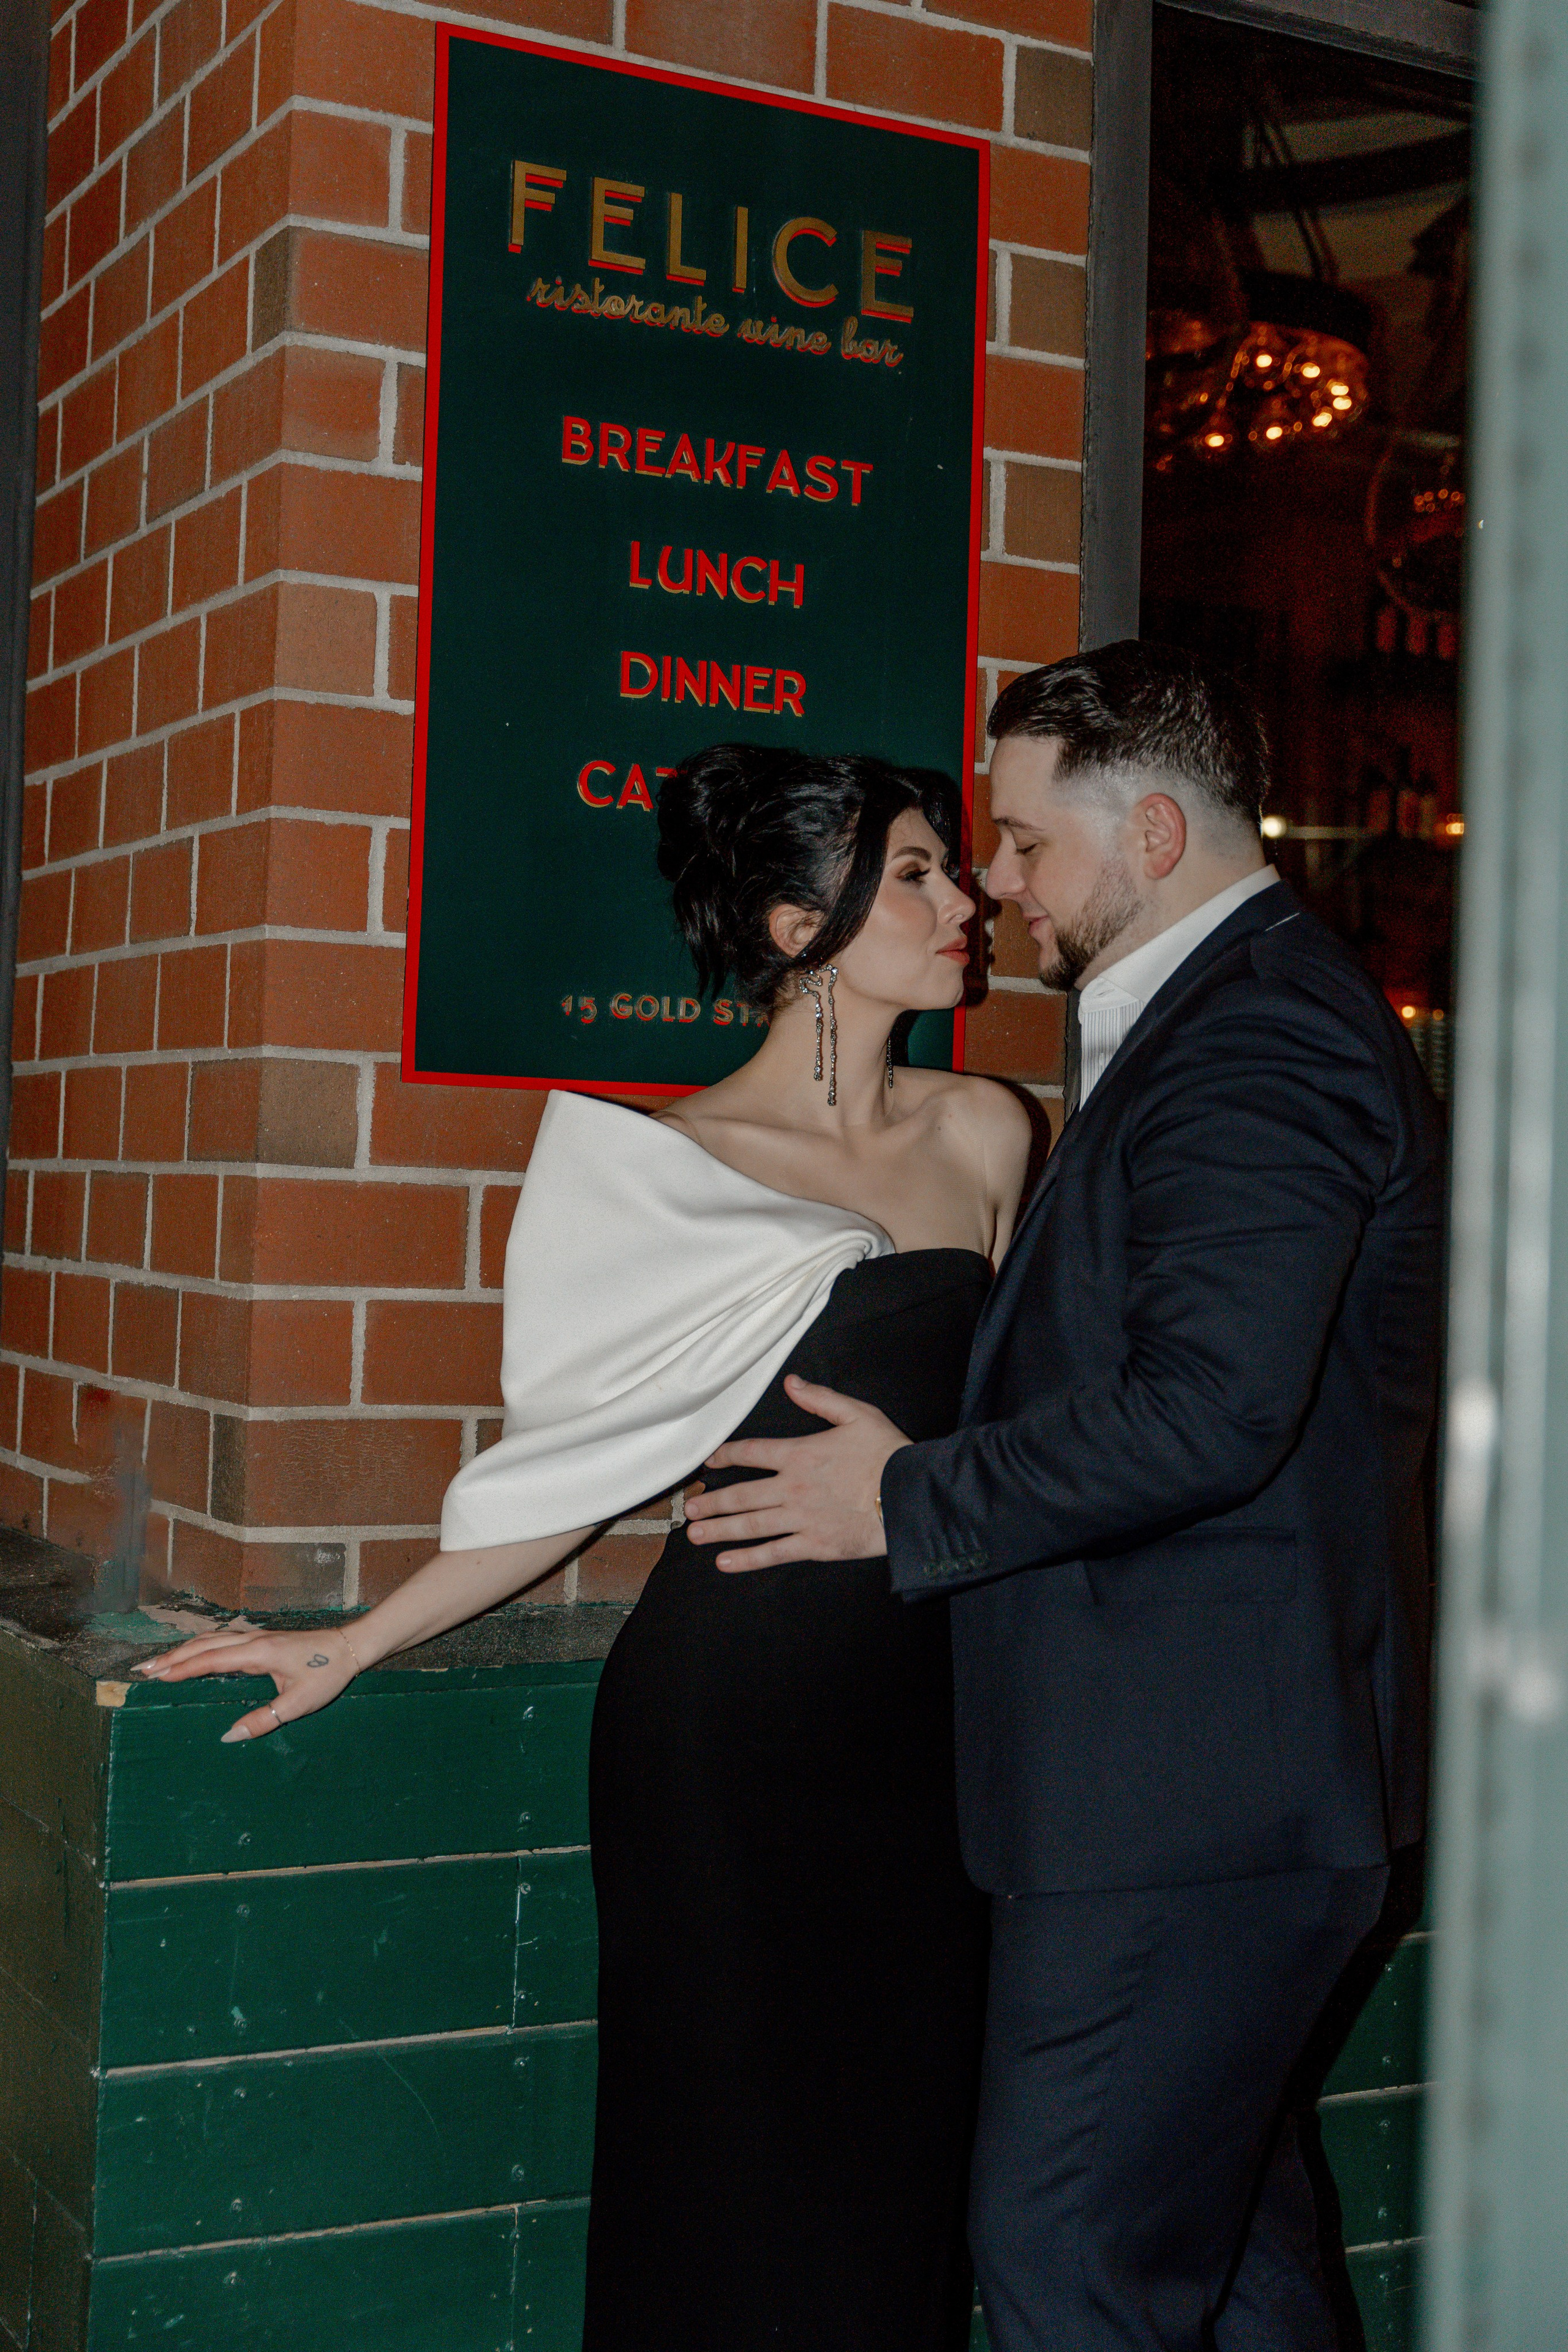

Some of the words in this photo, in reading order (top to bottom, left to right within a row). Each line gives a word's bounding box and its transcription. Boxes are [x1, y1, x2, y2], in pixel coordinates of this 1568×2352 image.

[508, 160, 913, 323] FELICE
[526, 276, 729, 337] ristorante
[841, 315, 904, 367] bar
[562, 415, 873, 506] BREAKFAST
[629, 540, 804, 609] LUNCH
[620, 650, 806, 717] DINNER
[561, 995, 598, 1023] 15
[610, 992, 702, 1023] GOLD
